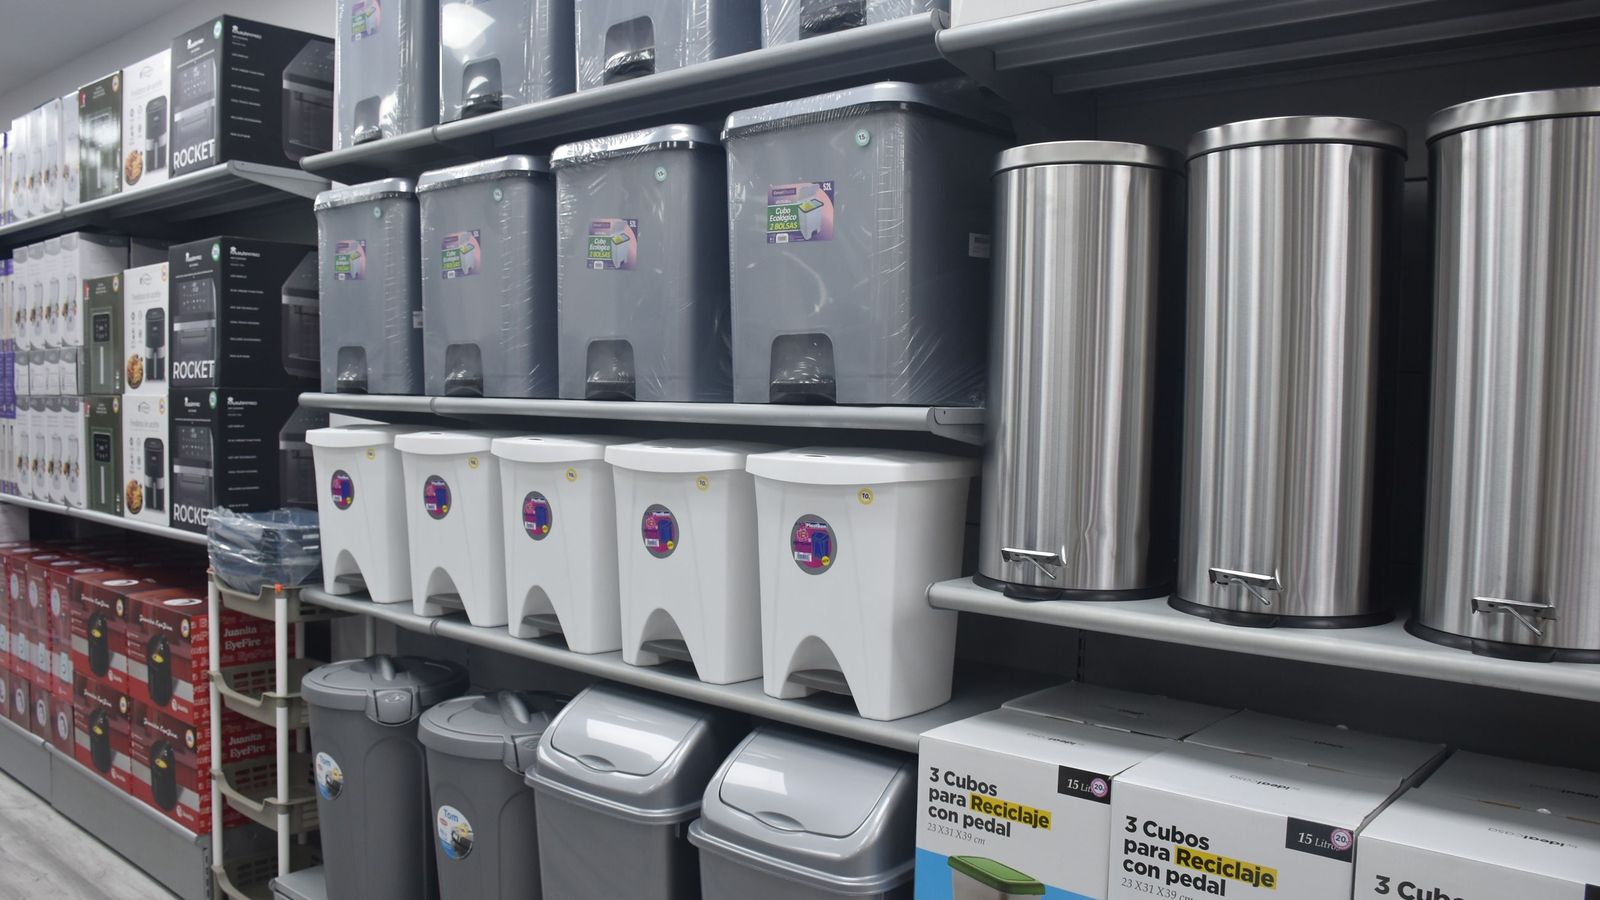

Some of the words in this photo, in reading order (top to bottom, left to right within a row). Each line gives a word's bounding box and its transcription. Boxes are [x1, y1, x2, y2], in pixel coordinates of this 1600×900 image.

[173, 139, 215, 170] ROCKET
[774, 222, 798, 230] BOLSAS
[173, 360, 215, 380] ROCKET
[224, 626, 257, 637] Juanita
[224, 639, 261, 650] EyeFire
[228, 734, 262, 746] Juanita
[230, 745, 266, 758] EyeFire
[929, 766, 940, 782] 3
[944, 771, 998, 796] Cubos
[1068, 778, 1080, 790] 15
[443, 808, 459, 822] Tom
[929, 787, 966, 808] para
[971, 795, 1050, 828] Reciclaje
[928, 805, 958, 824] con
[963, 813, 1010, 838] pedal
[928, 822, 937, 832] 23
[974, 836, 986, 846] cm
[1124, 815, 1138, 834] 3
[1142, 820, 1210, 850] Cubos
[1298, 832, 1312, 844] 15
[1124, 837, 1170, 862] para
[1176, 848, 1276, 888] Reciclaje
[1122, 858, 1160, 880] con
[1166, 867, 1226, 896] pedal
[1122, 878, 1132, 888] 23
[1374, 874, 1390, 894] 3
[1398, 881, 1464, 900] Cub
